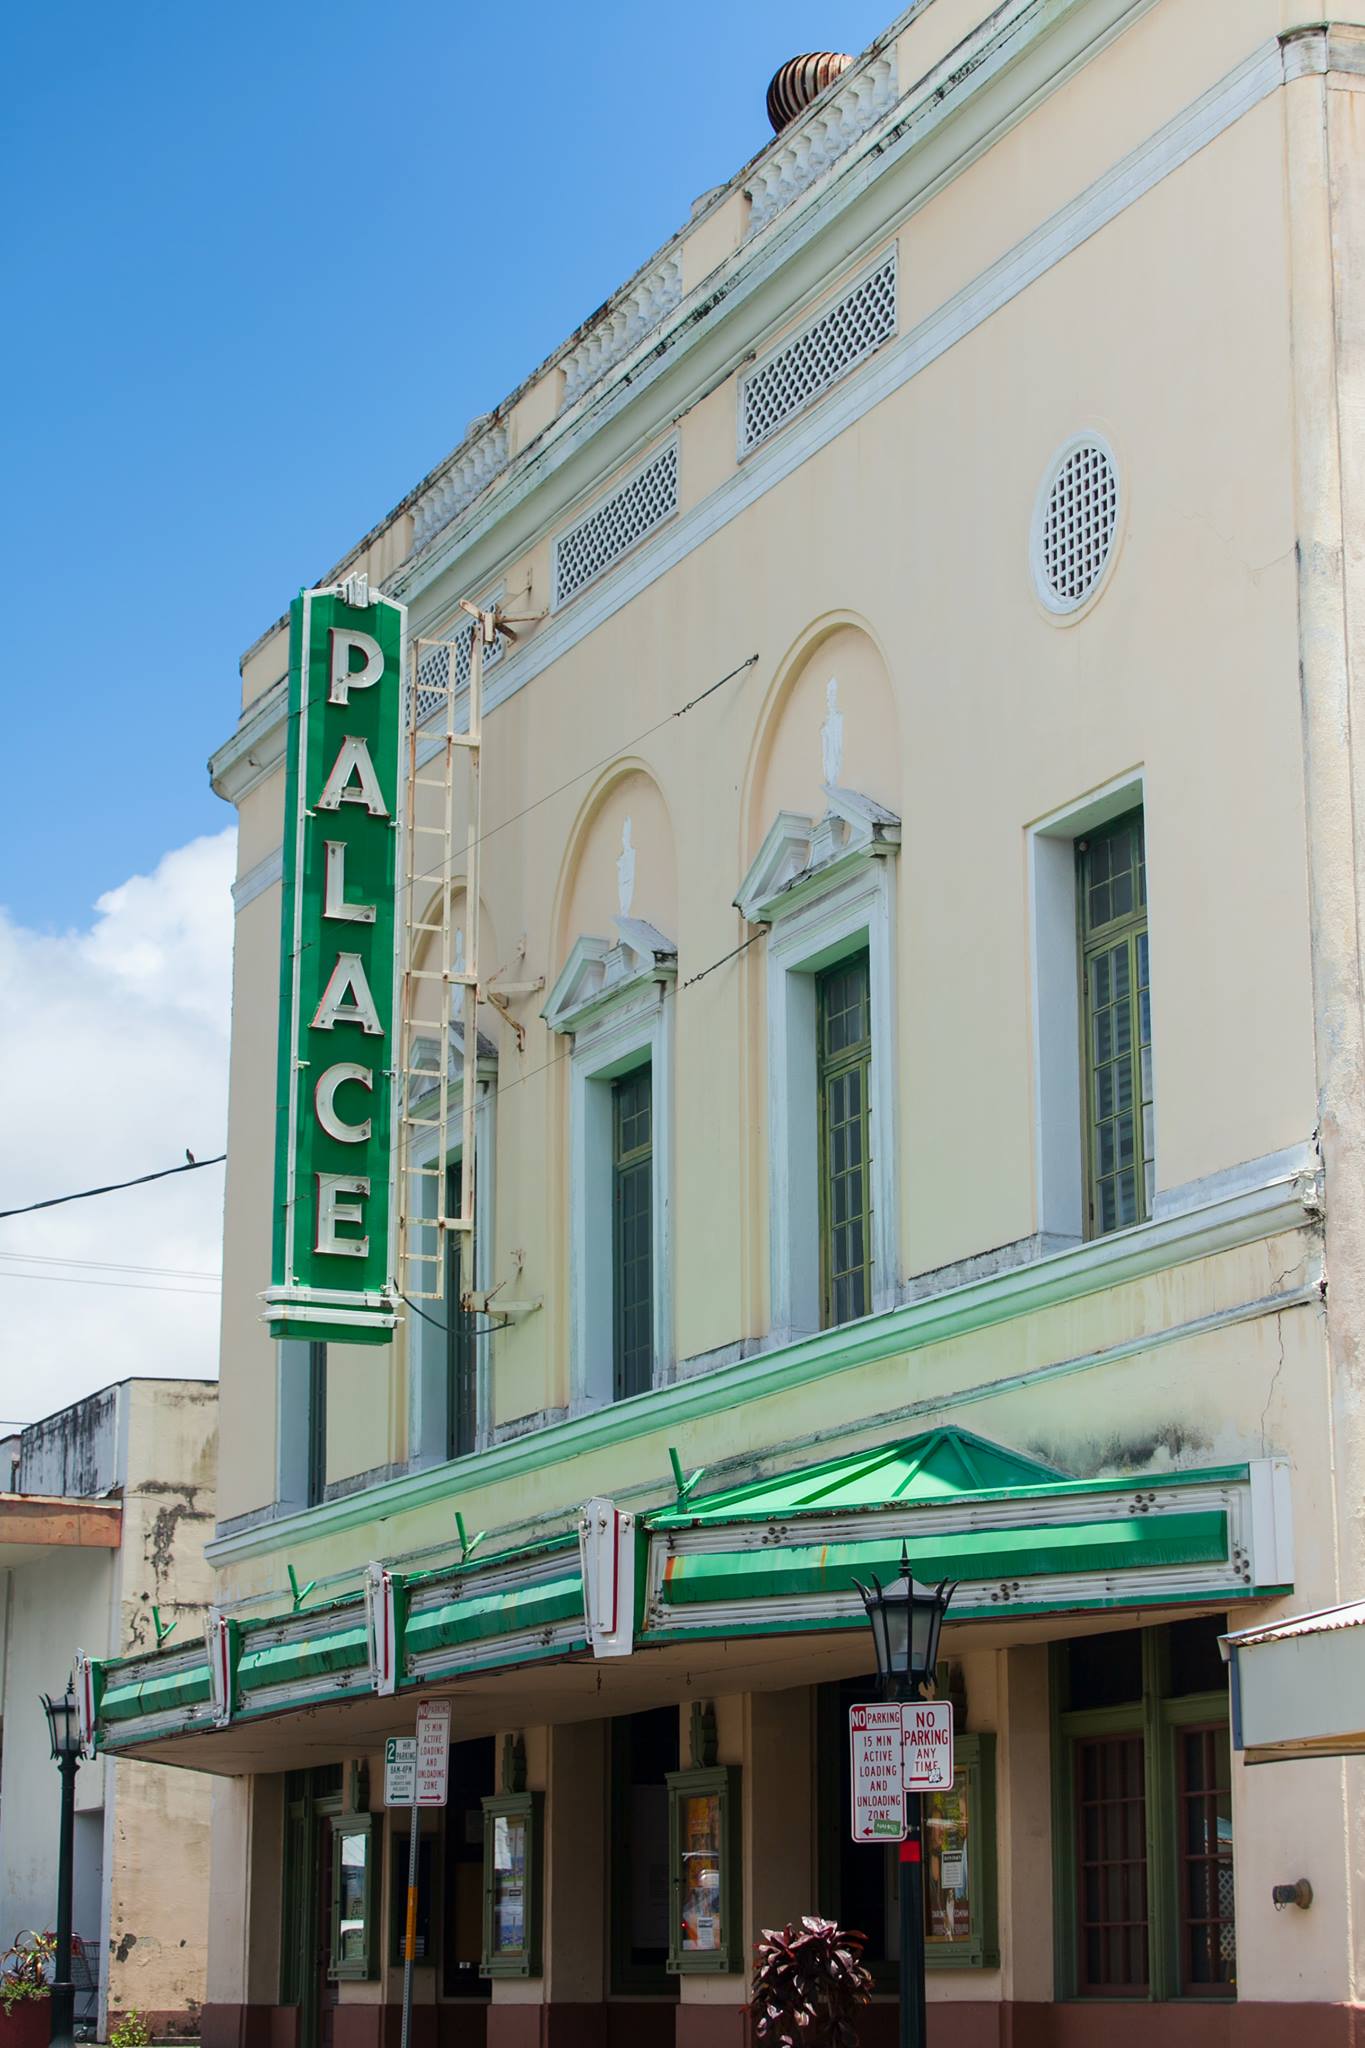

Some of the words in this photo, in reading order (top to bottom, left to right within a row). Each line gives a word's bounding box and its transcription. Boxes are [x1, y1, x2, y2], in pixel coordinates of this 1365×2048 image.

[308, 626, 392, 1258] PALACE
[429, 1704, 449, 1713] PARKING
[851, 1710, 866, 1727] NO
[867, 1711, 900, 1724] PARKING
[916, 1711, 935, 1728] NO
[424, 1723, 430, 1731] 15
[431, 1723, 442, 1731] MIN
[423, 1735, 442, 1743] ACTIVE
[863, 1736, 872, 1746] 15
[876, 1736, 892, 1746] MIN
[904, 1729, 948, 1746] PARKING
[388, 1743, 396, 1760] 2
[396, 1751, 416, 1760] PARKING
[420, 1746, 444, 1755] LOADING
[863, 1750, 893, 1762] ACTIVE
[916, 1748, 936, 1759] ANY
[426, 1758, 437, 1767] AND
[914, 1761, 938, 1772] TIME
[418, 1770, 445, 1778] UNLOADING
[860, 1765, 897, 1777] LOADING
[423, 1781, 438, 1790] ZONE
[870, 1780, 888, 1791] AND
[857, 1795, 901, 1807] UNLOADING
[868, 1810, 890, 1821] ZONE
